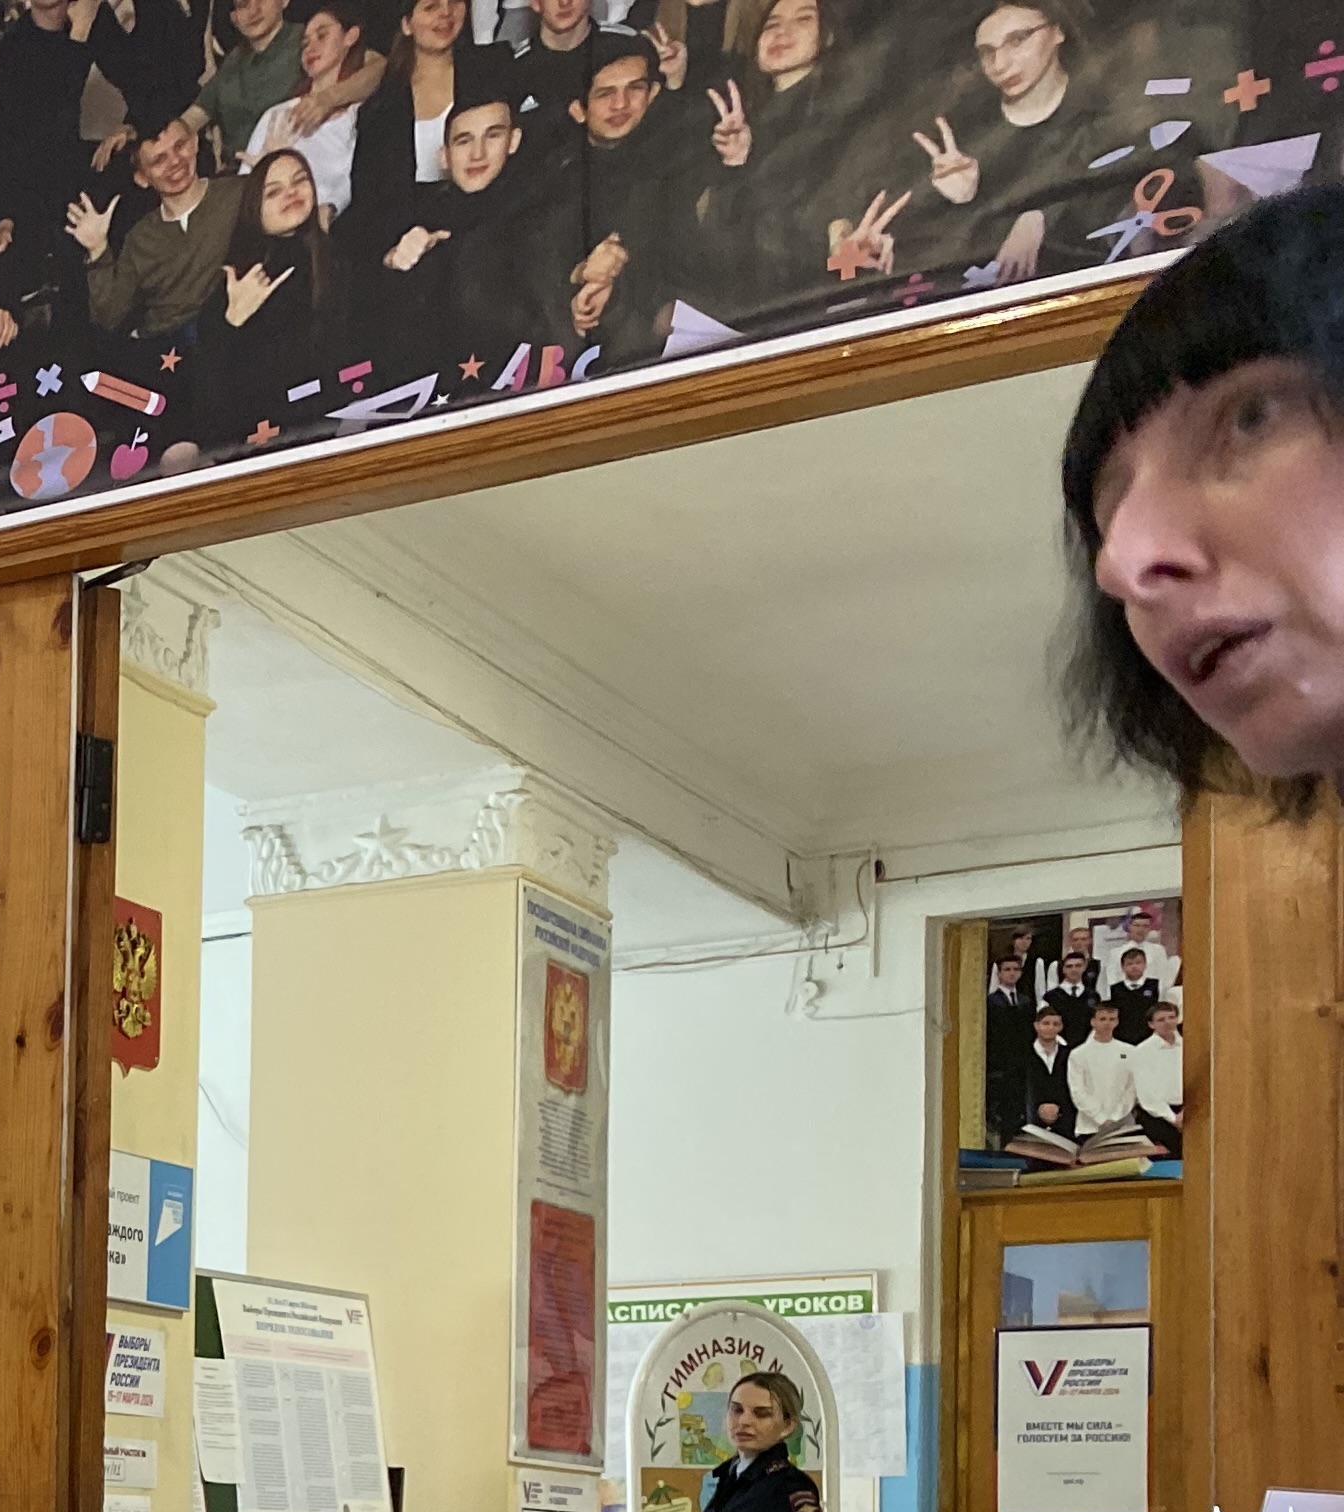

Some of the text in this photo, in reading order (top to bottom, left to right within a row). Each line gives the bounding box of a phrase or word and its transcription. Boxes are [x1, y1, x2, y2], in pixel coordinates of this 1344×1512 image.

[117, 1190, 140, 1205] проект
[763, 1294, 864, 1314] УРОКОВ
[118, 1335, 151, 1351] ВЫБОРЫ
[113, 1353, 160, 1373] ПРЕЗИДЕНТА
[664, 1336, 766, 1400] ГИМНАЗИЯ
[109, 1372, 141, 1388] РОССИИ
[1025, 1421, 1064, 1431] ВМЕСТЕ
[1065, 1421, 1084, 1431] МЫ
[1086, 1421, 1113, 1431] СИЛА
[1017, 1433, 1069, 1443] ГОЛОСУЕМ
[1070, 1433, 1083, 1443] ЗА
